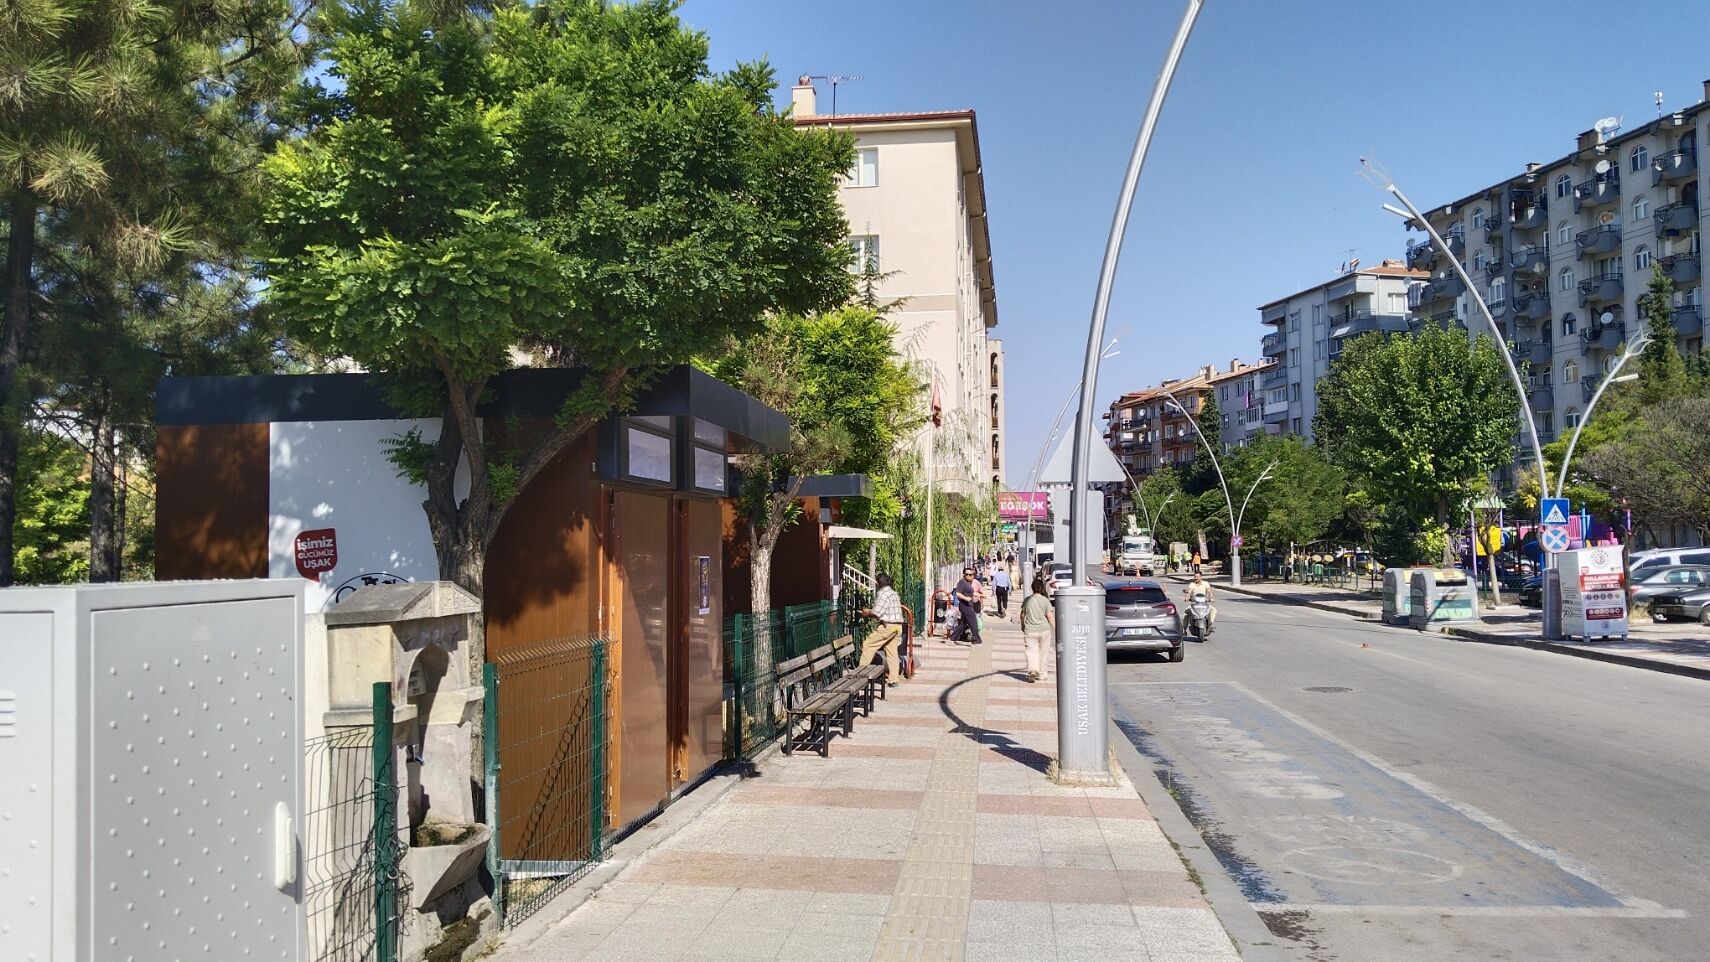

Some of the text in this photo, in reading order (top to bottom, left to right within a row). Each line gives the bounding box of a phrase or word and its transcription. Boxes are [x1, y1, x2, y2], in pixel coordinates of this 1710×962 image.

[296, 536, 334, 551] işimiz
[298, 549, 335, 559] GÜCÜMÜZ
[303, 558, 332, 570] UŞAK
